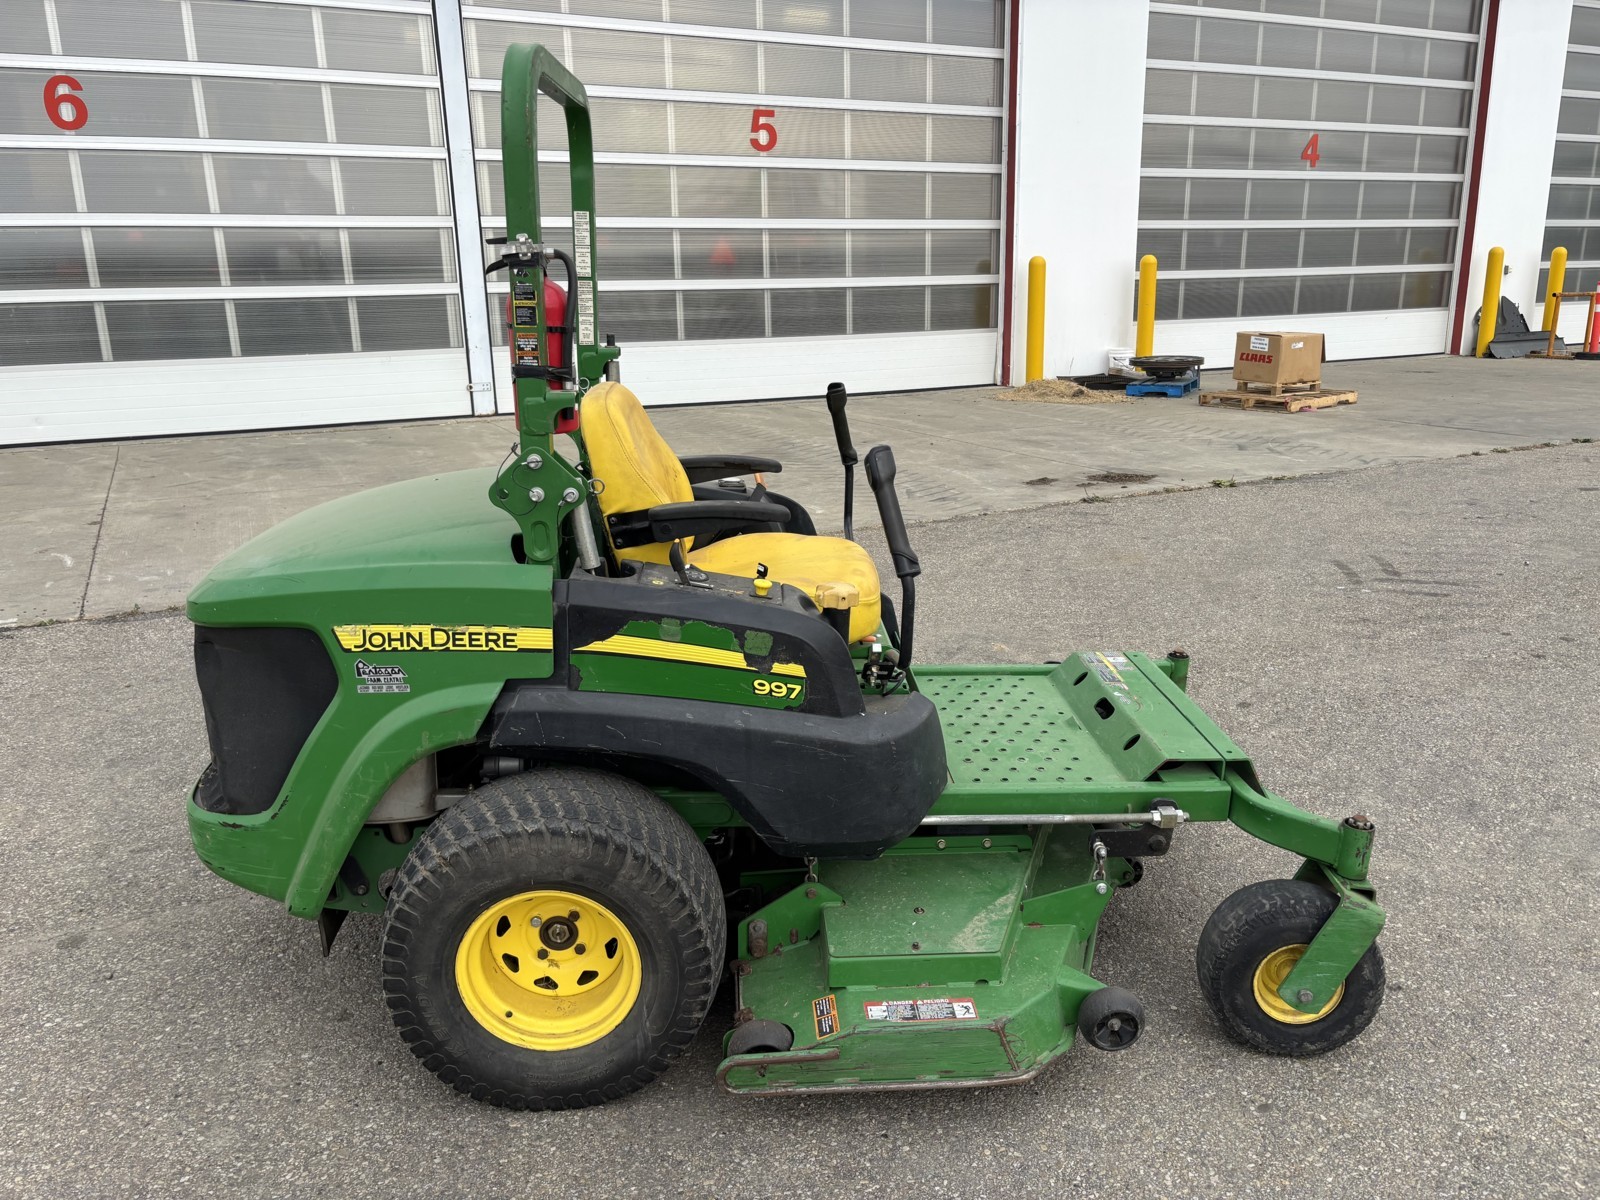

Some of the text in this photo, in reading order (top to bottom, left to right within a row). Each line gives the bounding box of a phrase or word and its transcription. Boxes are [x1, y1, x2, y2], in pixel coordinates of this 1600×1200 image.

[43, 75, 88, 130] 6
[750, 108, 777, 153] 5
[1301, 133, 1320, 167] 4
[1239, 352, 1273, 364] CLAAS
[354, 628, 518, 648] JOHN DEERE
[752, 678, 803, 700] 997
[414, 974, 467, 1058] KENDA
